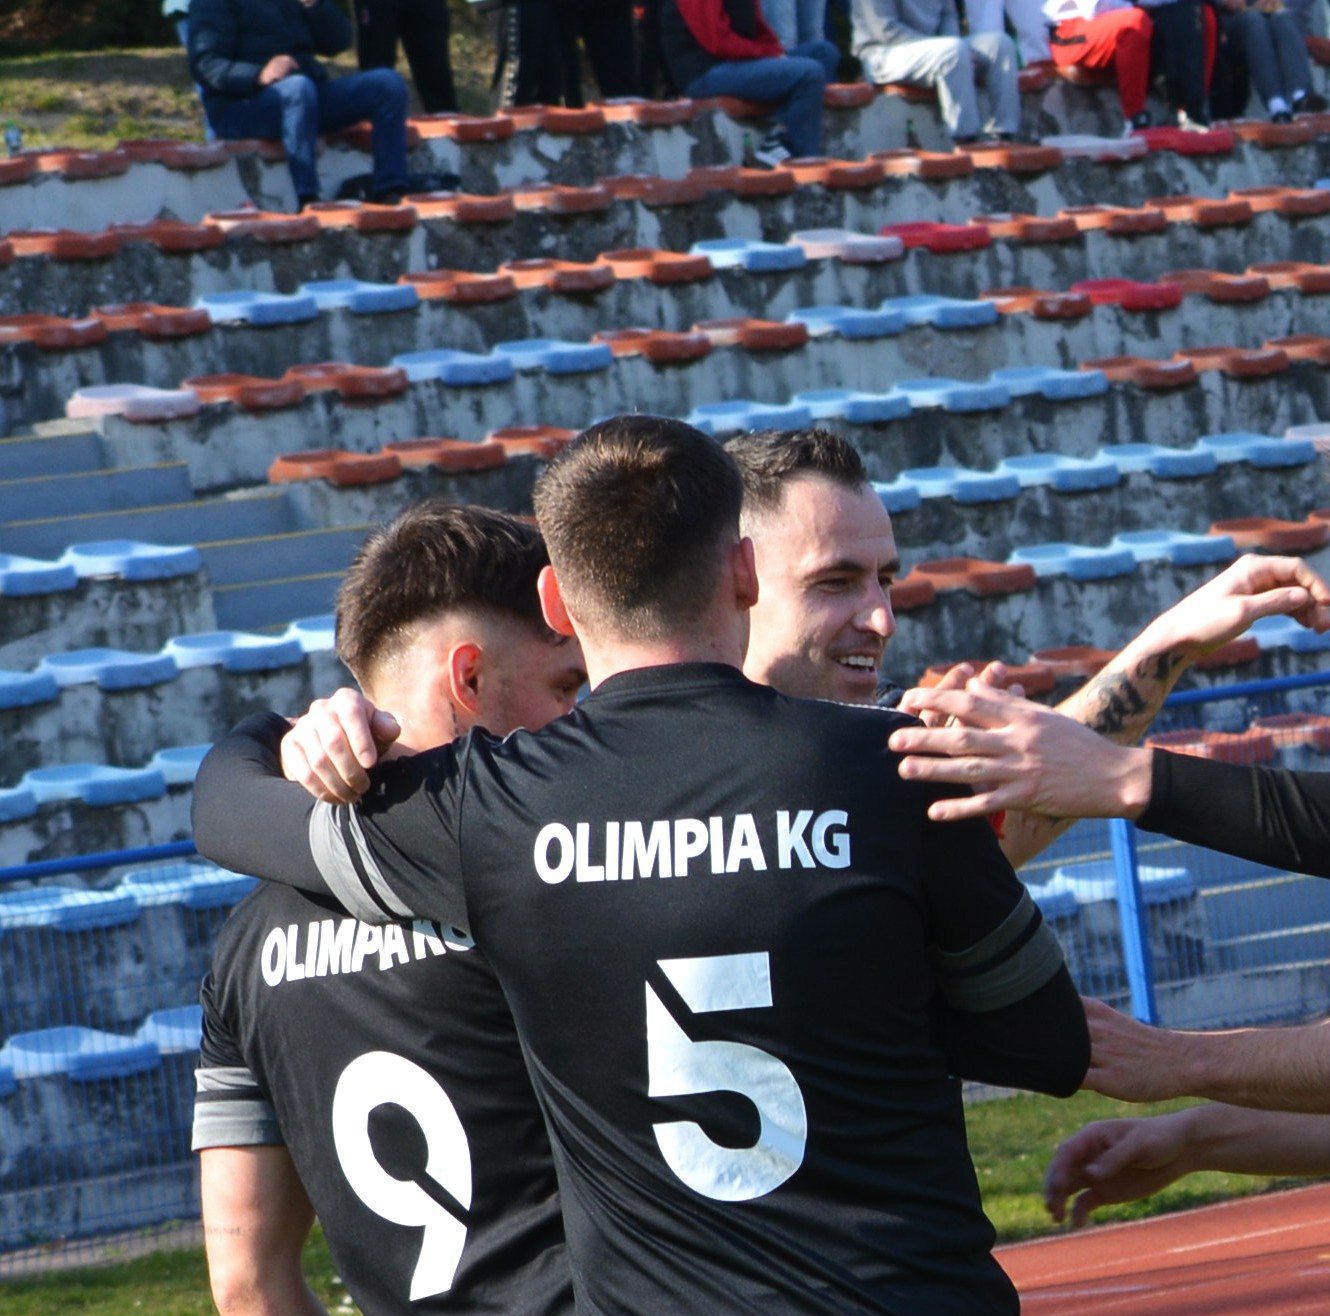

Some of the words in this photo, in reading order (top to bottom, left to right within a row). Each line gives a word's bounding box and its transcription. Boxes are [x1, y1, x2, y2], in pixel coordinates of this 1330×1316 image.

[534, 813, 768, 884] OLIMPIA
[776, 810, 851, 869] KG
[332, 1051, 472, 1301] 9
[646, 951, 808, 1201] 5
